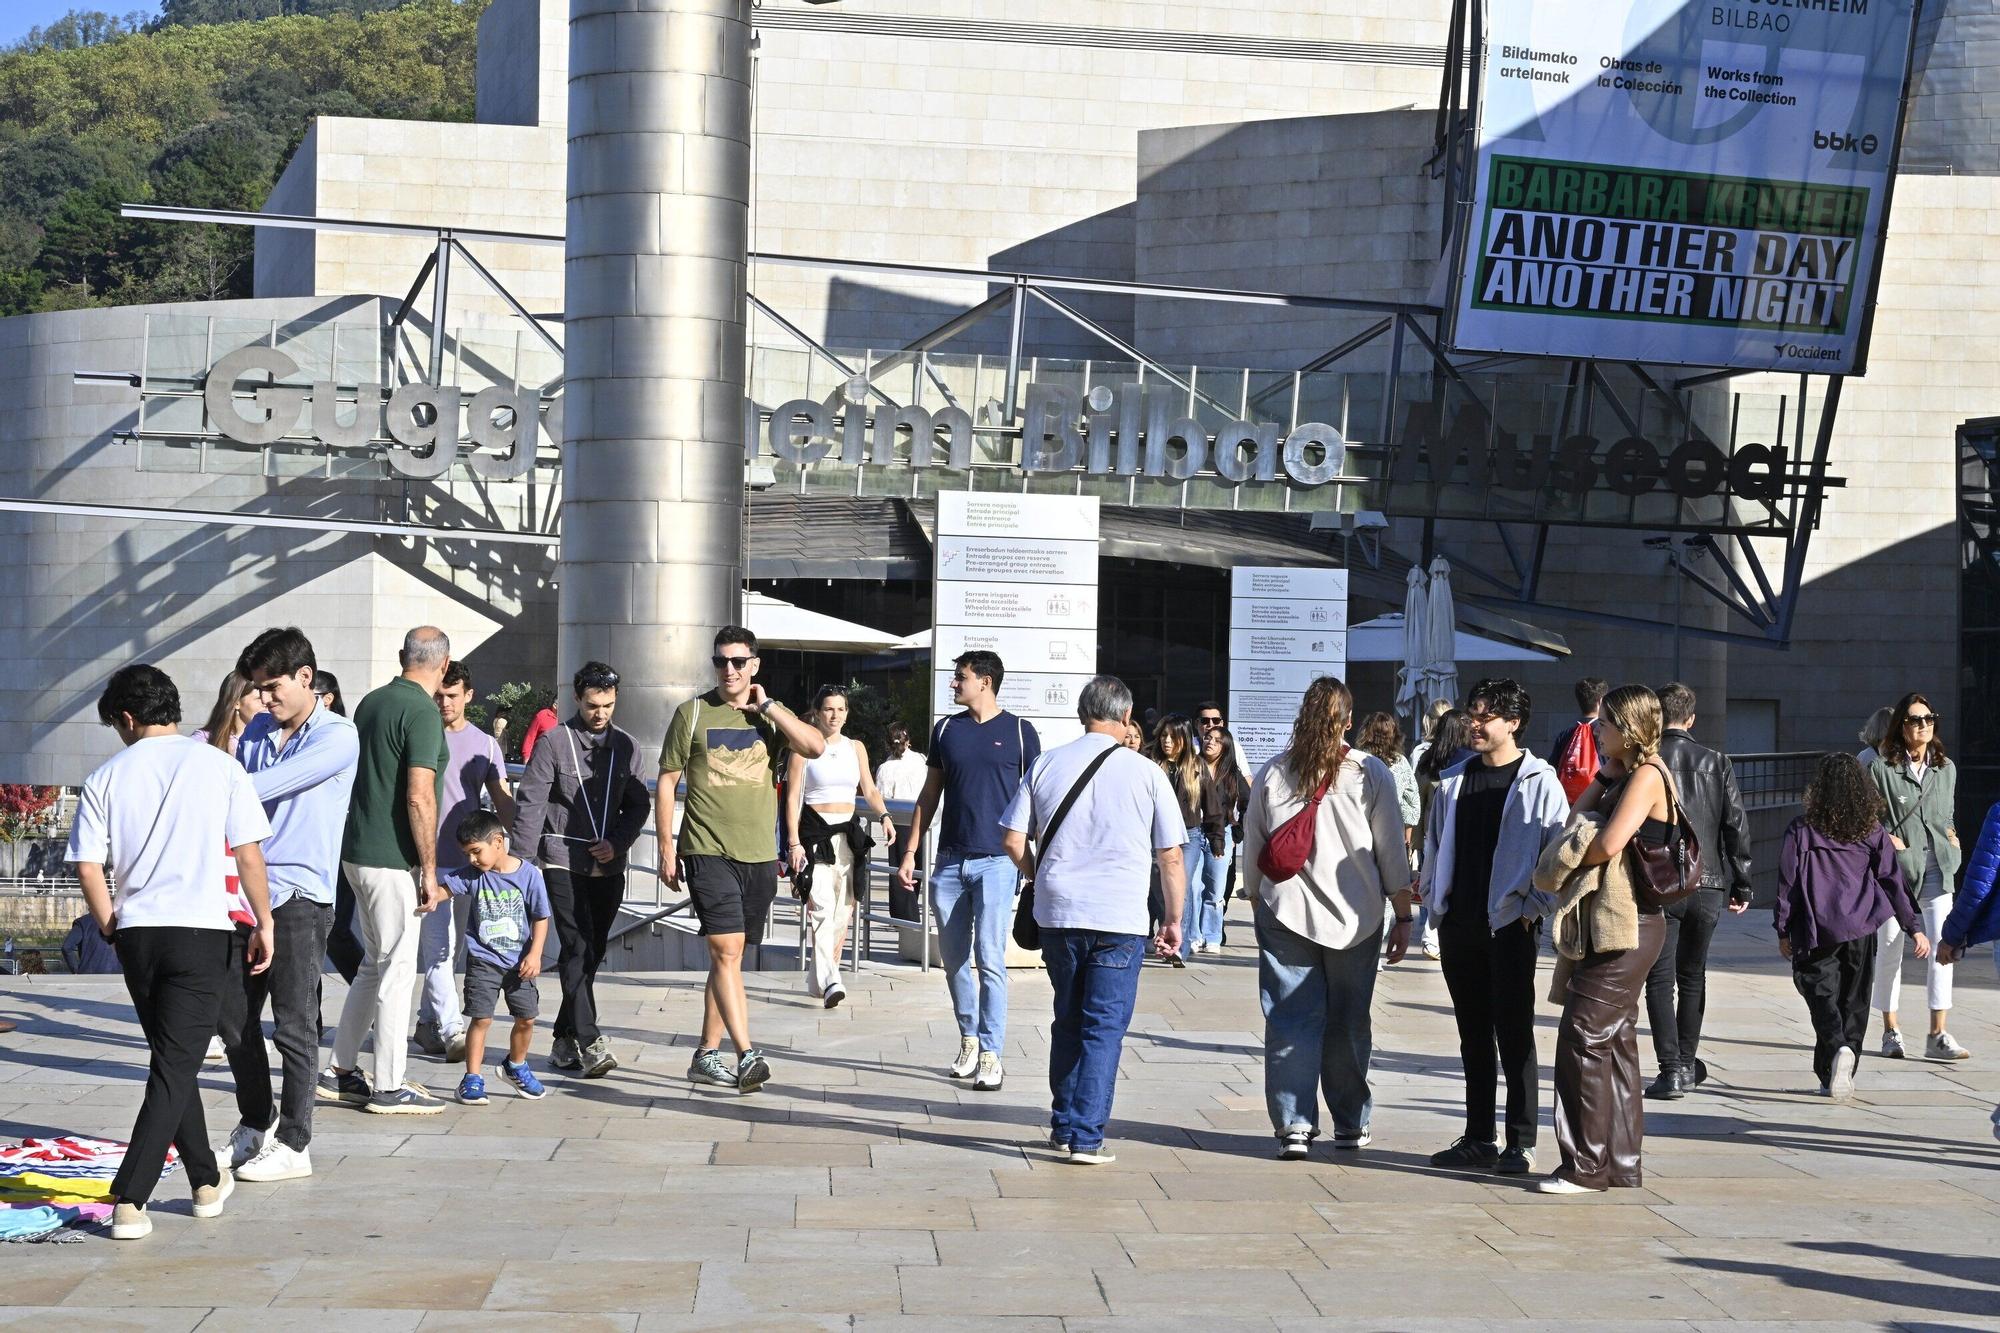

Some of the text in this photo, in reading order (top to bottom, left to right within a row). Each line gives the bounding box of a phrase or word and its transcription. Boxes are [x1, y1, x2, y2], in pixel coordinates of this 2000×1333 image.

[1711, 7, 1790, 33] BILBAO
[1502, 45, 1578, 66] Bildumako
[1600, 56, 1663, 74] Obras de
[1500, 65, 1570, 84] artelanak
[1707, 66, 1784, 86] Works from
[1597, 75, 1683, 96] la Colección
[1704, 85, 1797, 106] the Collection
[1813, 130, 1858, 153] bbk
[1498, 161, 1860, 235] BARBARA KRUGER
[1490, 212, 1853, 284] ANOTHER DAY
[1482, 260, 1845, 326] ANOTHER NIGHT
[1787, 344, 1841, 361] Occident
[1021, 382, 1345, 485] Bilbao
[1402, 401, 1788, 501] Museoa
